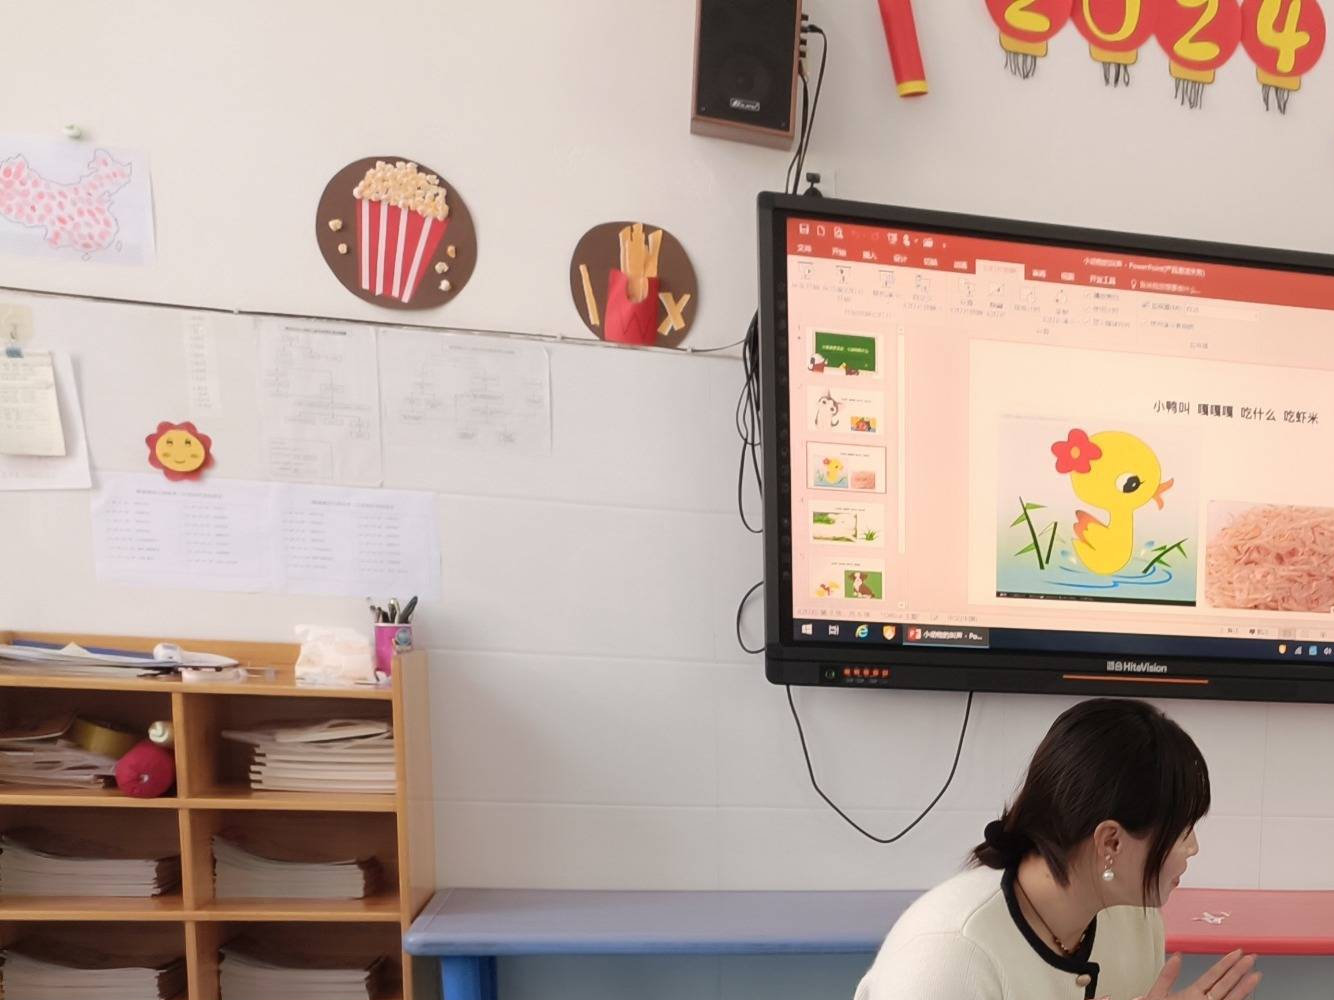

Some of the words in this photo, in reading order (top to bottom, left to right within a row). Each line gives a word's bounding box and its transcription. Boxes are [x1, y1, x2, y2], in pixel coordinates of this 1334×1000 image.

[1153, 400, 1191, 415] 小鸭叫
[1240, 406, 1276, 422] 吃什么
[1283, 409, 1319, 425] 吃虾米
